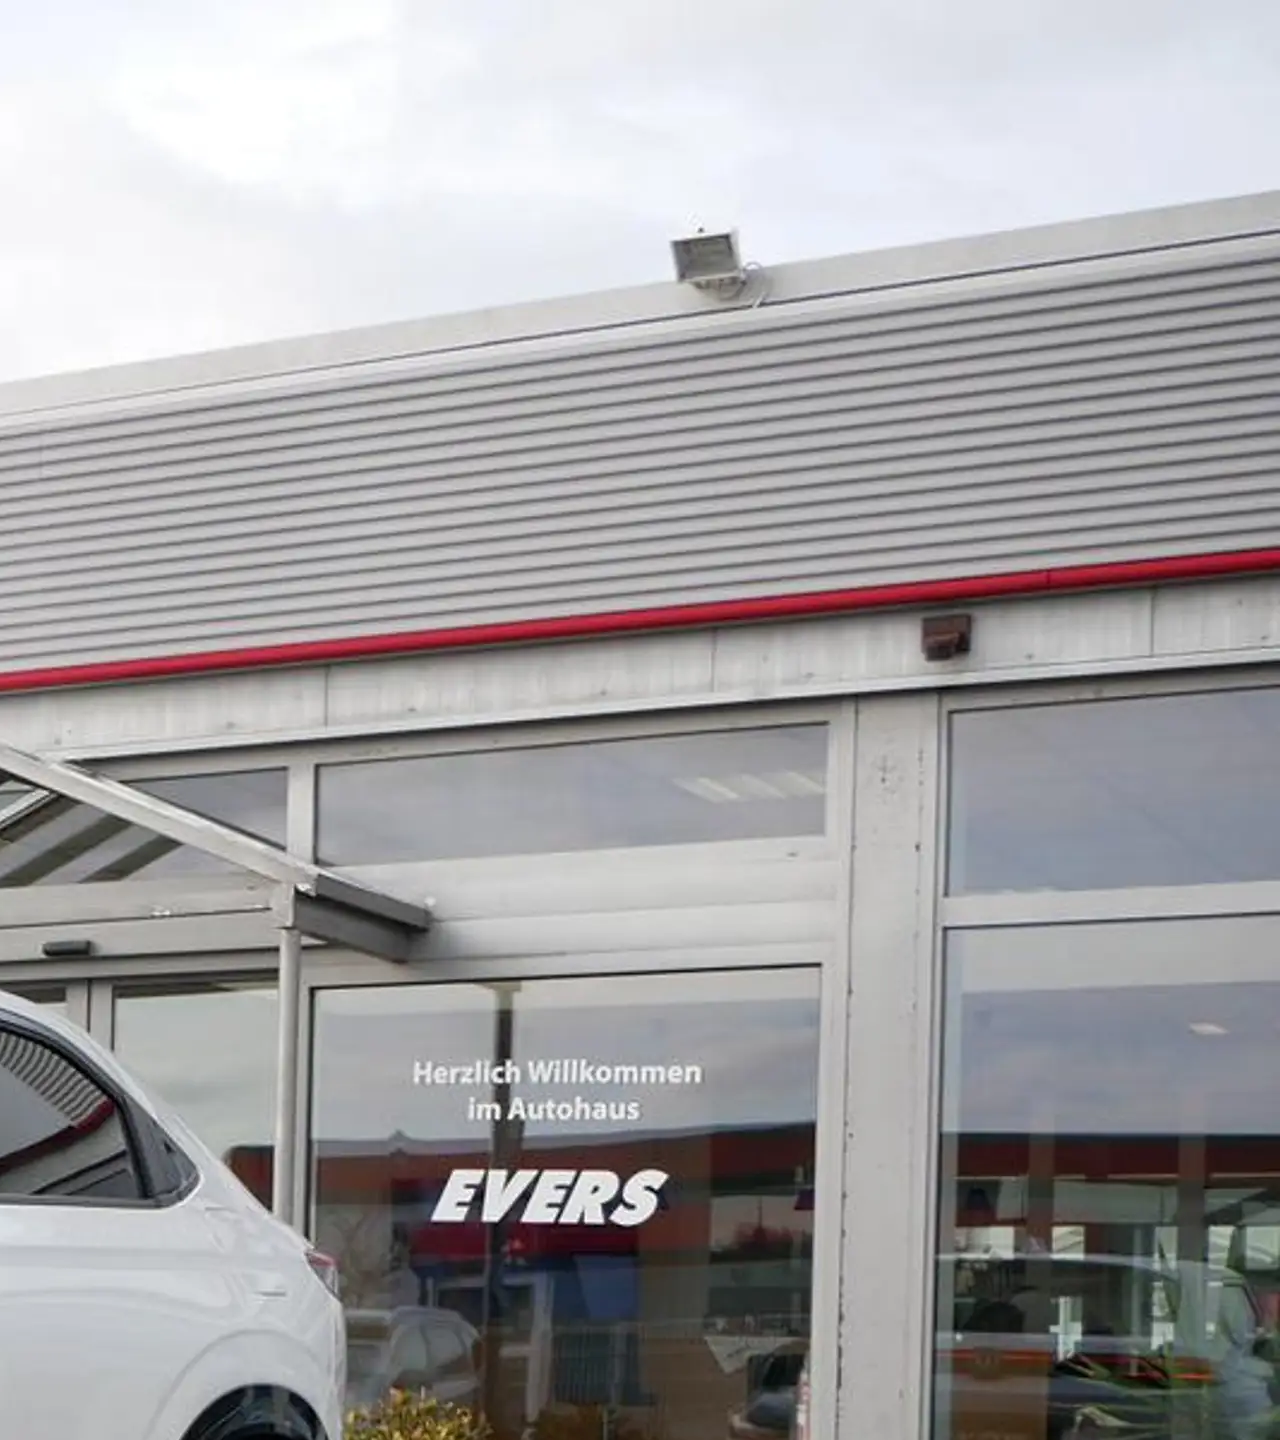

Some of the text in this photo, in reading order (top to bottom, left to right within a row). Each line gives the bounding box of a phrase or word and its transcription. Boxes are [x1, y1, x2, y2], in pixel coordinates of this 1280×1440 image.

[412, 1060, 702, 1086] Herzlich Willkommen
[467, 1096, 641, 1121] im Autohaus
[431, 1168, 670, 1227] EVERS
